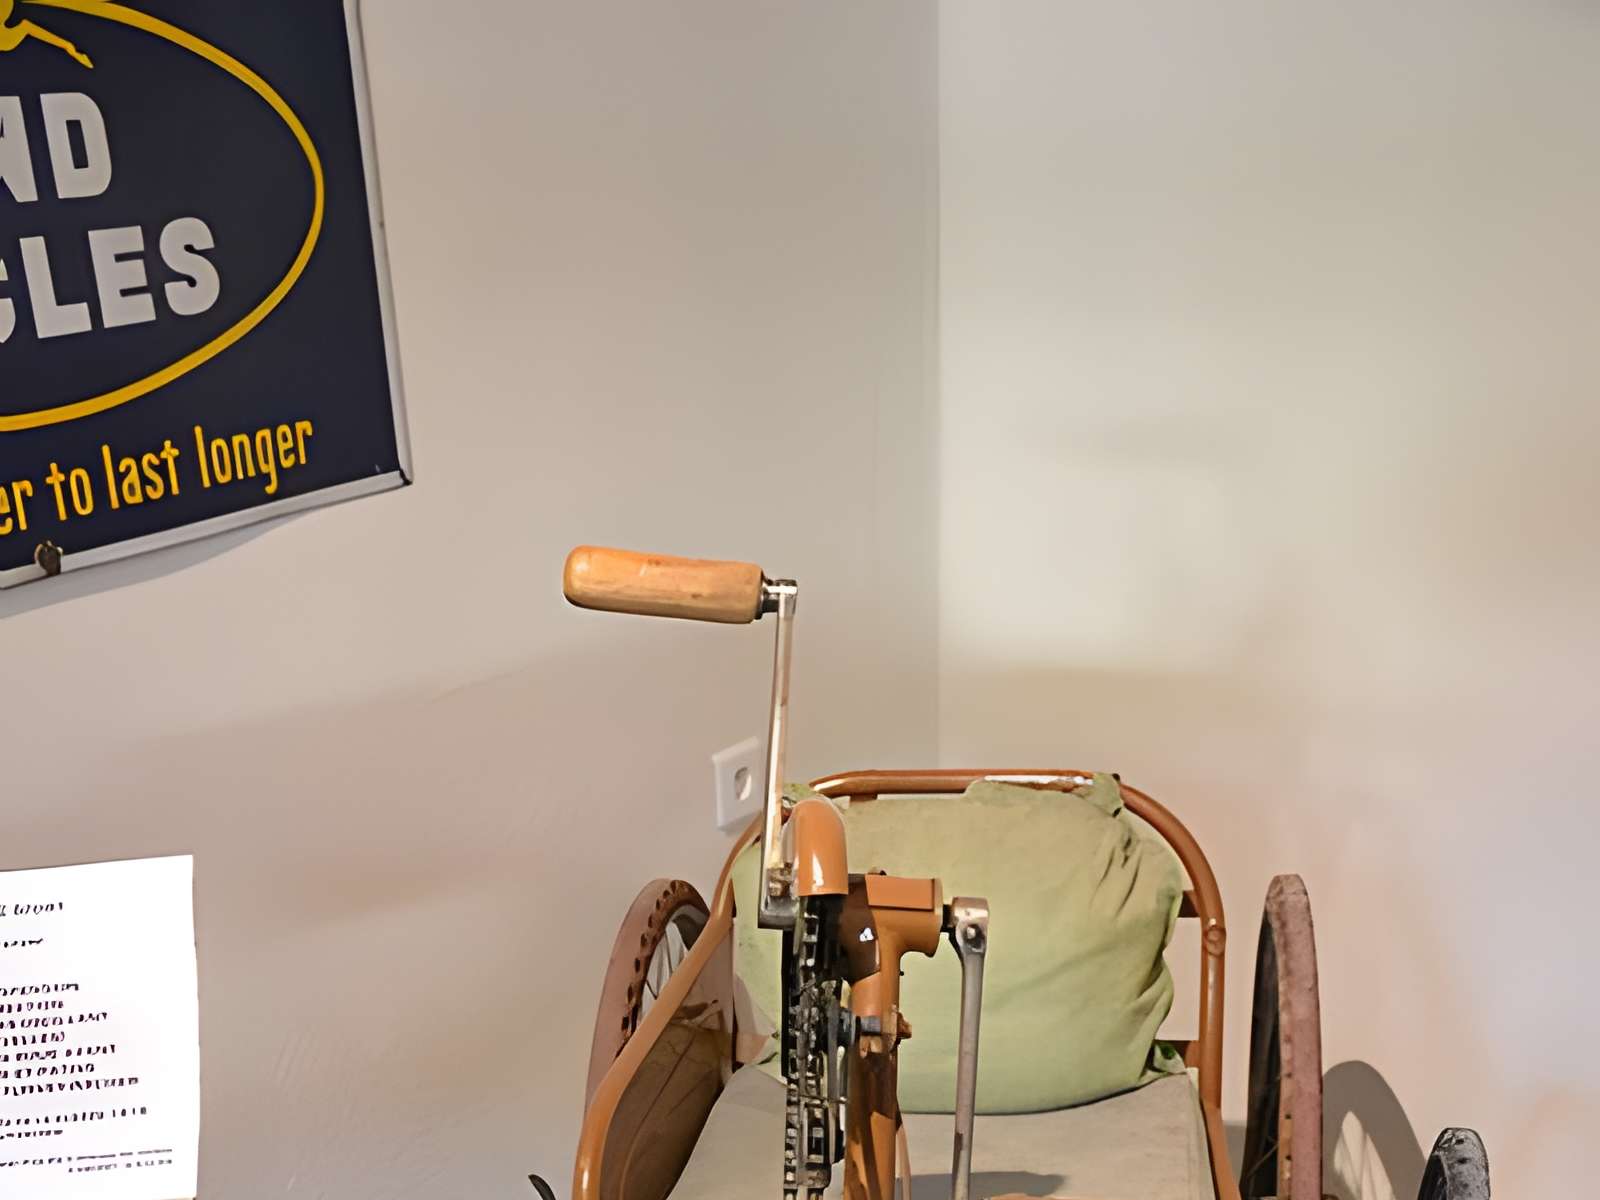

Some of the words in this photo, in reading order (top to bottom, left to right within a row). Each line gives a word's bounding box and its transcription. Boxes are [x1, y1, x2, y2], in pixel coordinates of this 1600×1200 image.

[46, 462, 94, 521] to
[101, 439, 180, 510] last
[194, 420, 313, 495] longer
